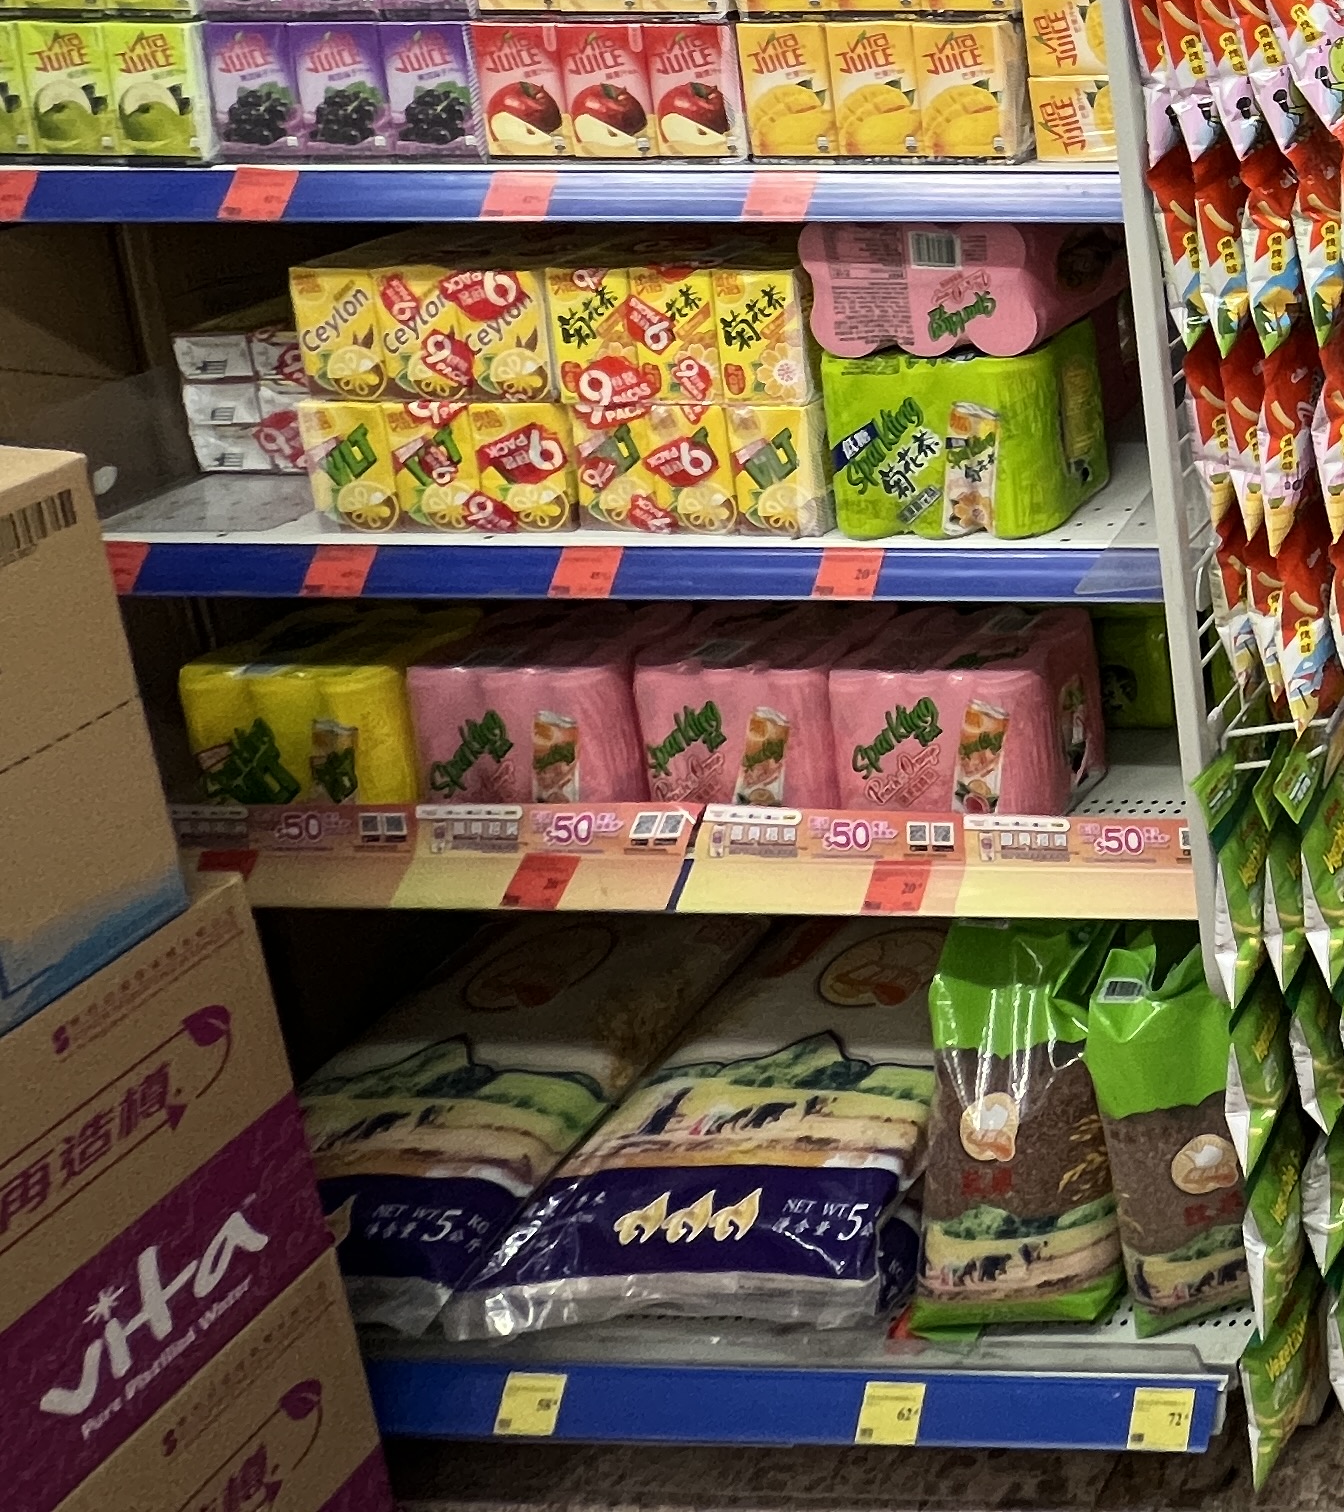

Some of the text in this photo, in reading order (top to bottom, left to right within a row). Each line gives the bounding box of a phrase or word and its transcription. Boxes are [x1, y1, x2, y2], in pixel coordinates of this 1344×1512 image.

[747, 48, 807, 75] JUICE
[835, 48, 896, 75] JUICE
[921, 48, 985, 76] JUICE
[302, 288, 369, 352] Ceylon
[557, 284, 618, 350] 菊花茶
[719, 283, 787, 352] 菊花茶
[325, 422, 377, 487] VLT
[878, 426, 943, 500] 菊花茶
[372, 1203, 404, 1219] NET
[411, 1205, 440, 1221] WT
[421, 1209, 462, 1244] 5
[781, 1197, 871, 1243] NET WT 5
[81, 1396, 123, 1442] Pure
[198, 1273, 253, 1331] Water
